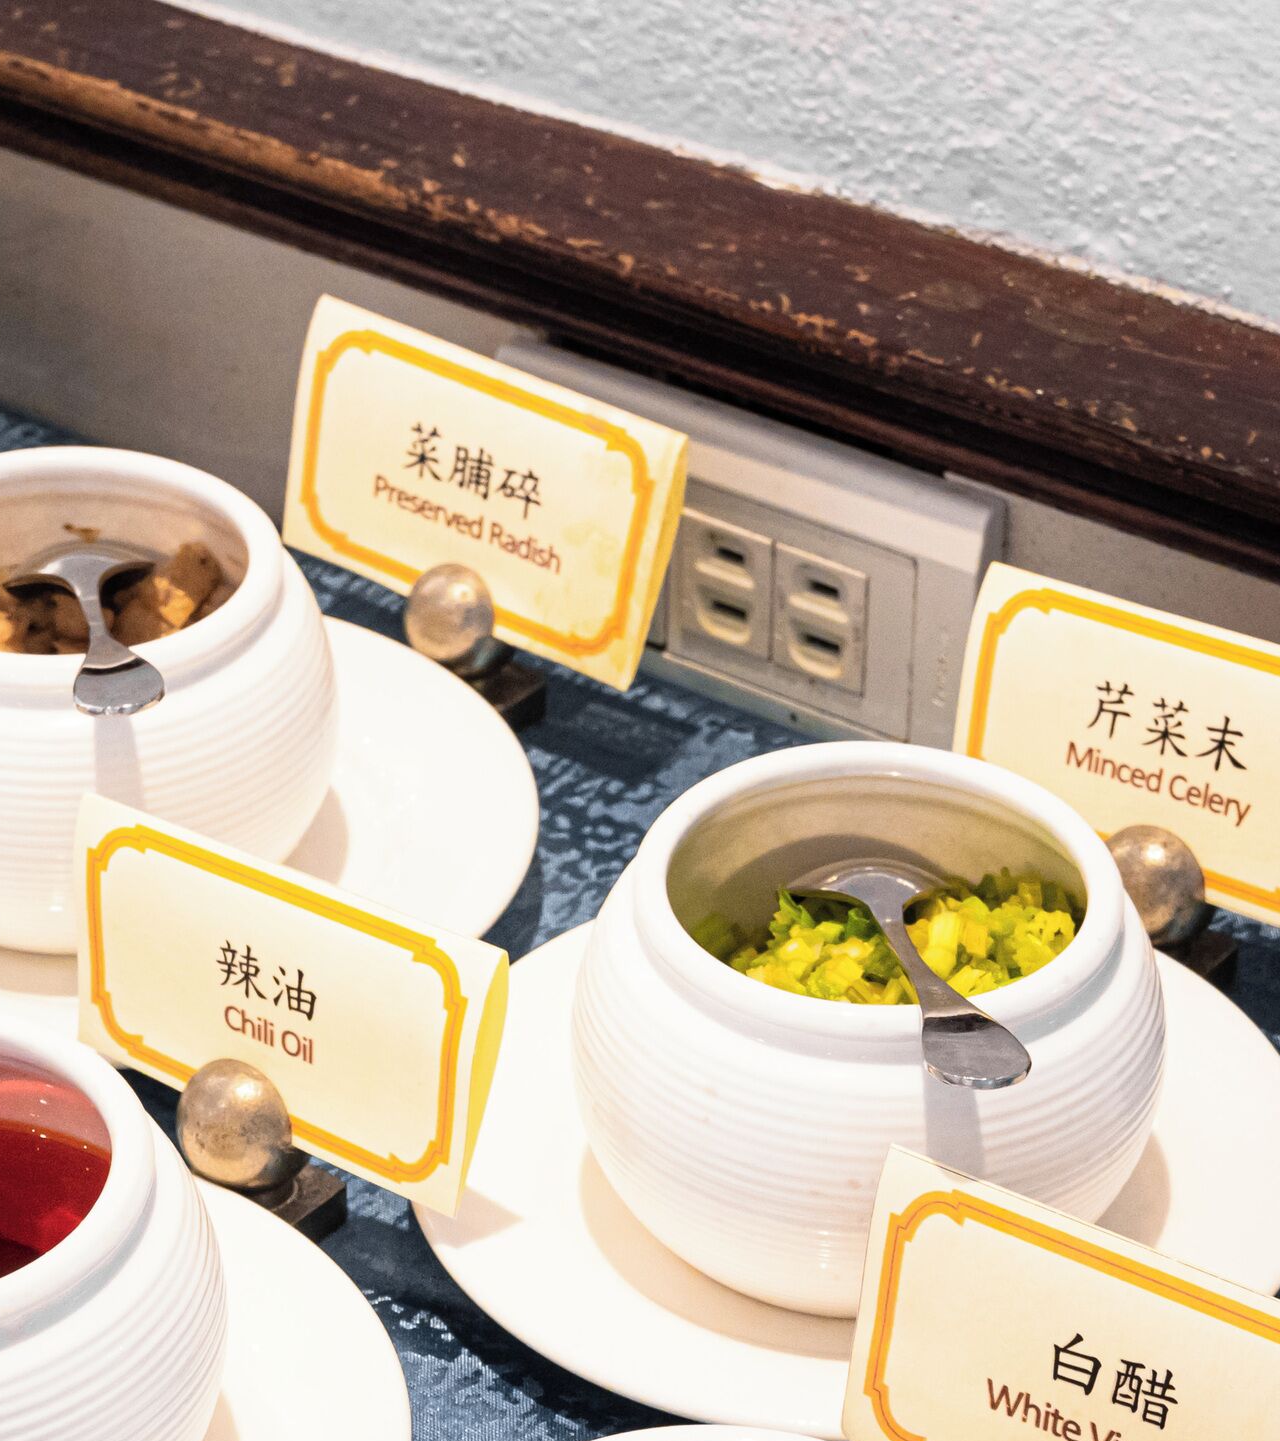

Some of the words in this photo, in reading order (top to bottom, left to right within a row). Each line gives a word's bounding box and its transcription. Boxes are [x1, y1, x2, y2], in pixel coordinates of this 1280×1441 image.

[404, 422, 542, 520] 菜脯碎
[374, 474, 484, 540] Preserved
[489, 522, 561, 575] Radish
[1086, 680, 1248, 772] 芹菜末
[1065, 740, 1164, 794] Minced
[1169, 774, 1251, 827] Celery
[216, 940, 317, 1022] 辣油
[223, 1005, 275, 1048] Chili
[281, 1030, 314, 1065] Oil
[1052, 1332, 1179, 1430] 白醋
